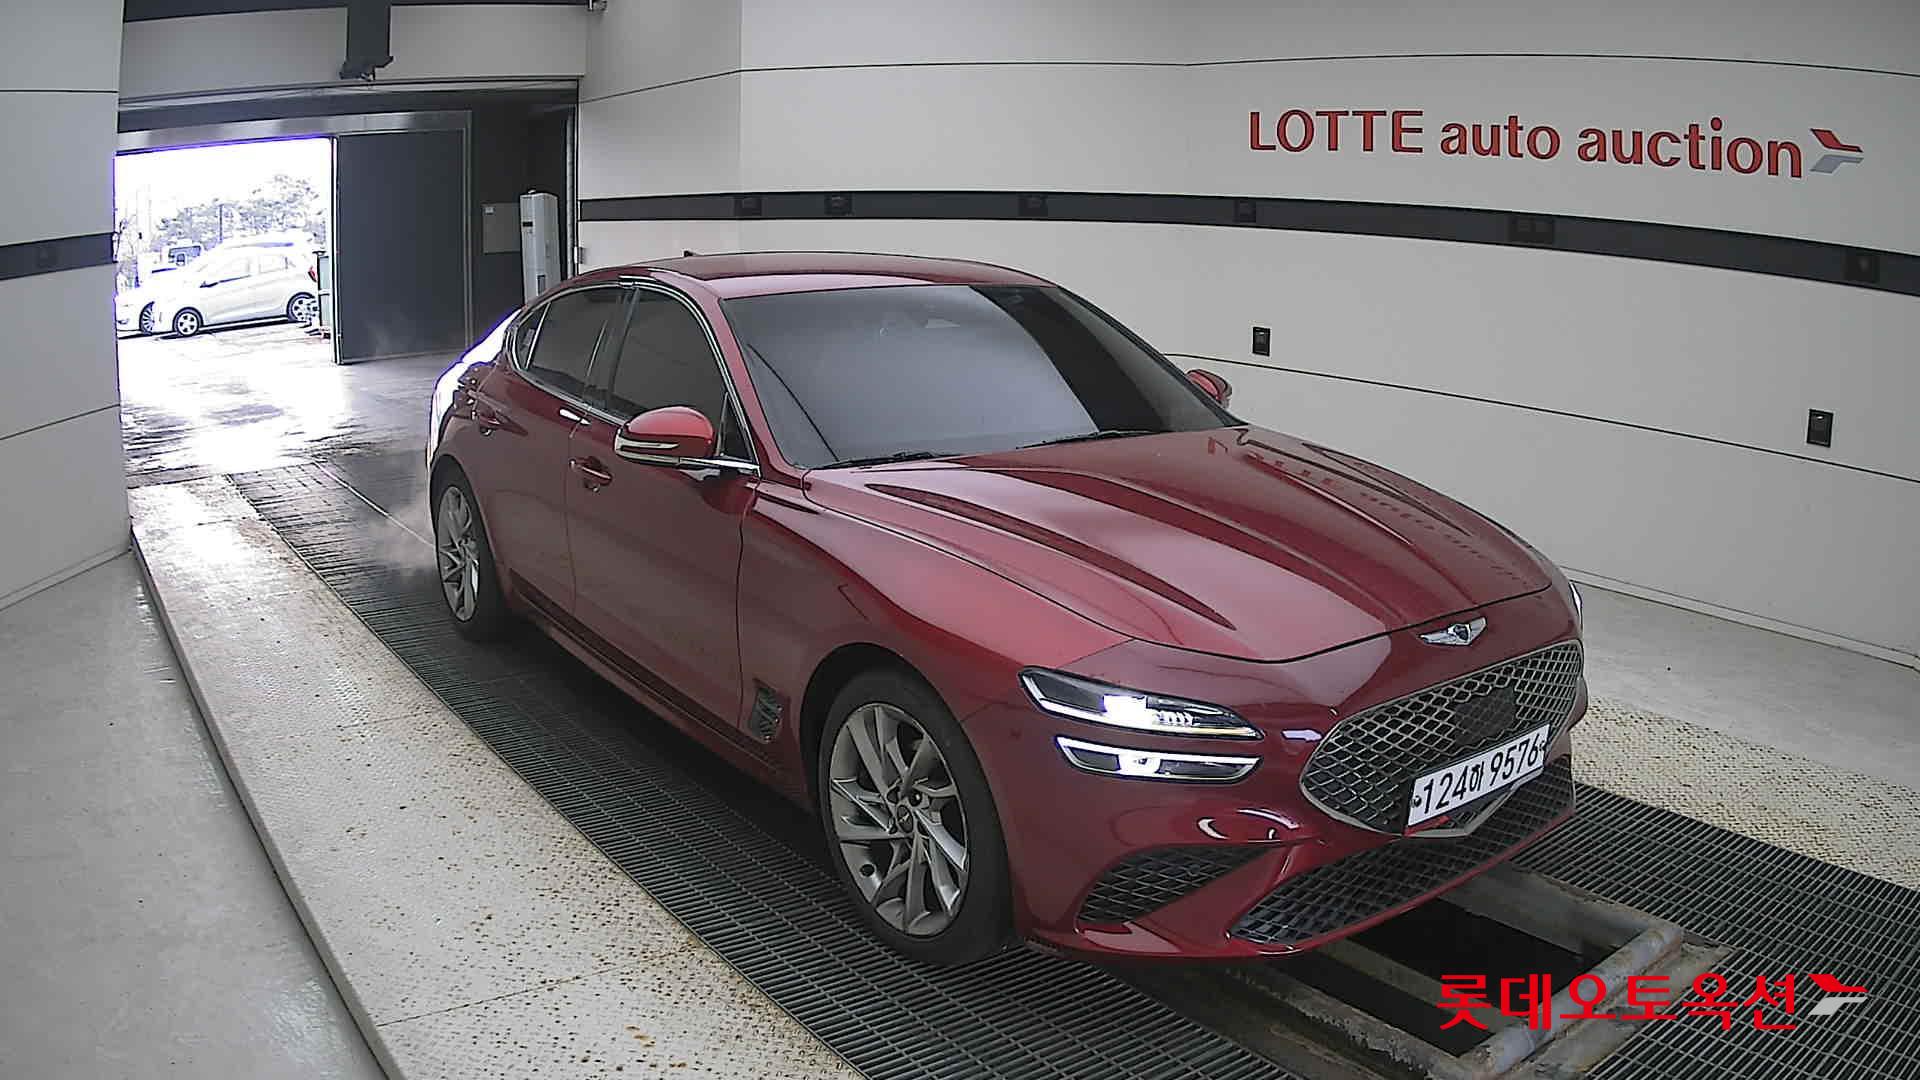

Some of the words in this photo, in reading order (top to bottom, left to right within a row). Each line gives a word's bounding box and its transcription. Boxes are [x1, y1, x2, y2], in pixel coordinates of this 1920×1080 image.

[1249, 110, 1424, 153] LOTTE
[1441, 115, 1561, 160] auto
[1577, 116, 1802, 178] auction
[1489, 733, 1540, 787] 9576
